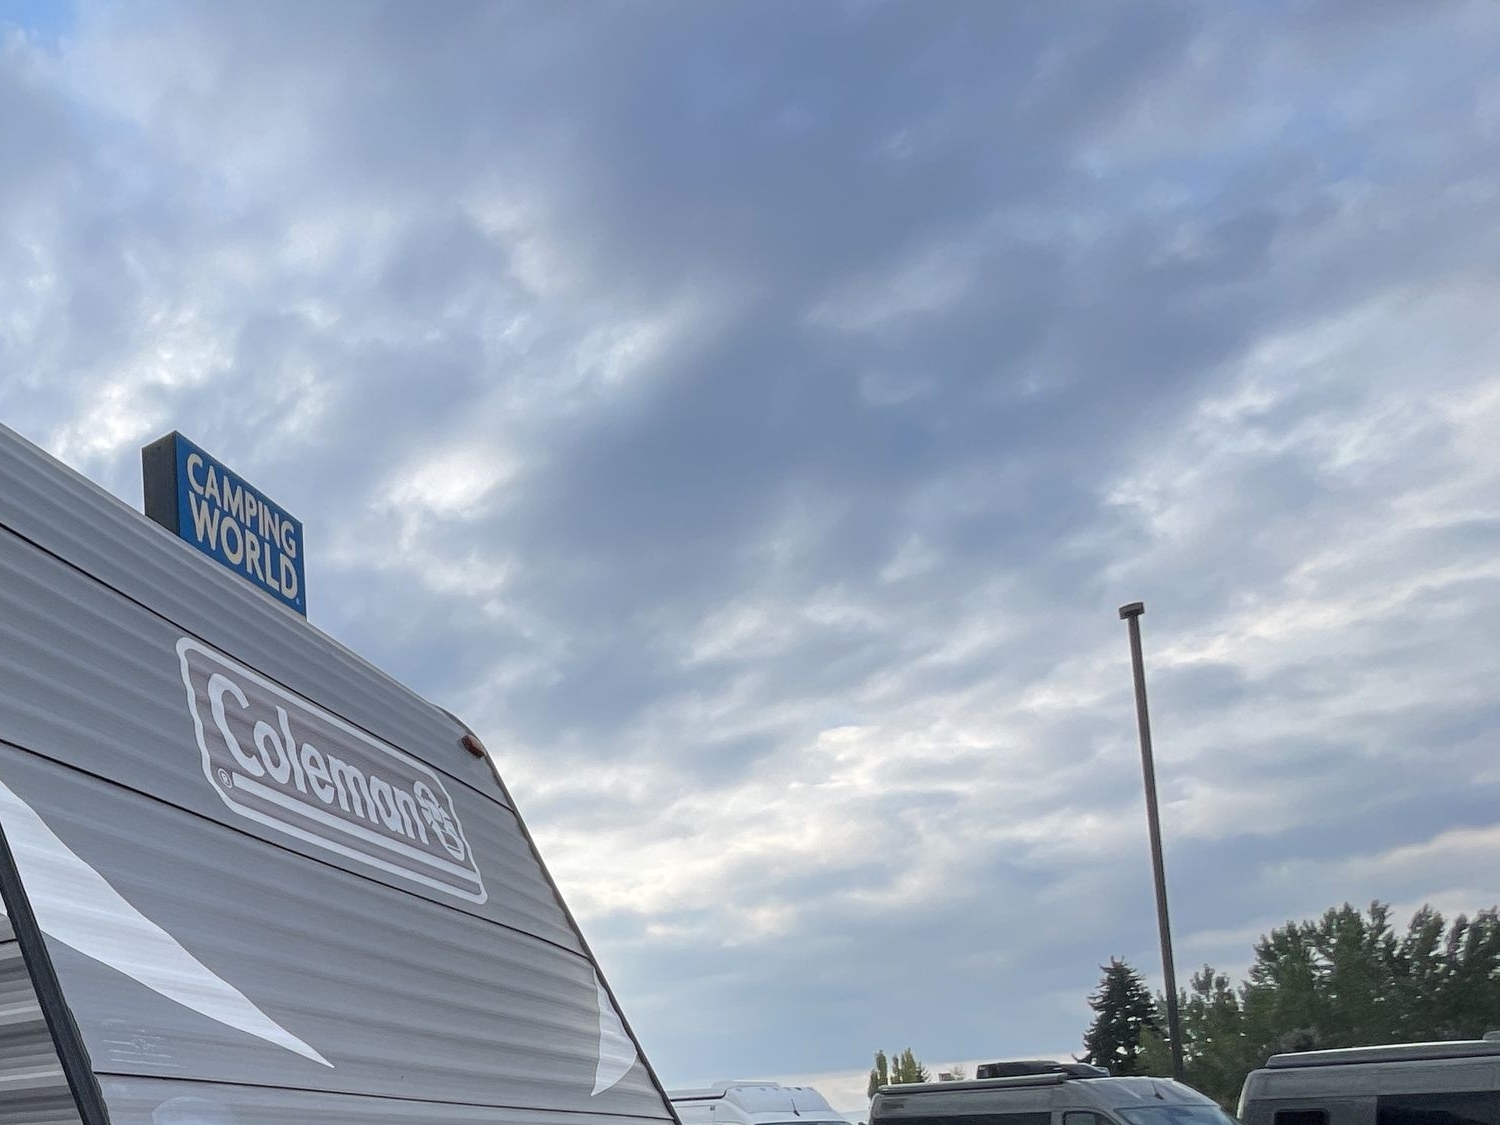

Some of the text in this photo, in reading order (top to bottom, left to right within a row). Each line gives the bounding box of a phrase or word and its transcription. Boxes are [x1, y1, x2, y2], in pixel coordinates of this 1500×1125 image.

[187, 453, 296, 558] CAMPING
[189, 490, 298, 600] WORLD
[208, 672, 430, 845] Coleman
